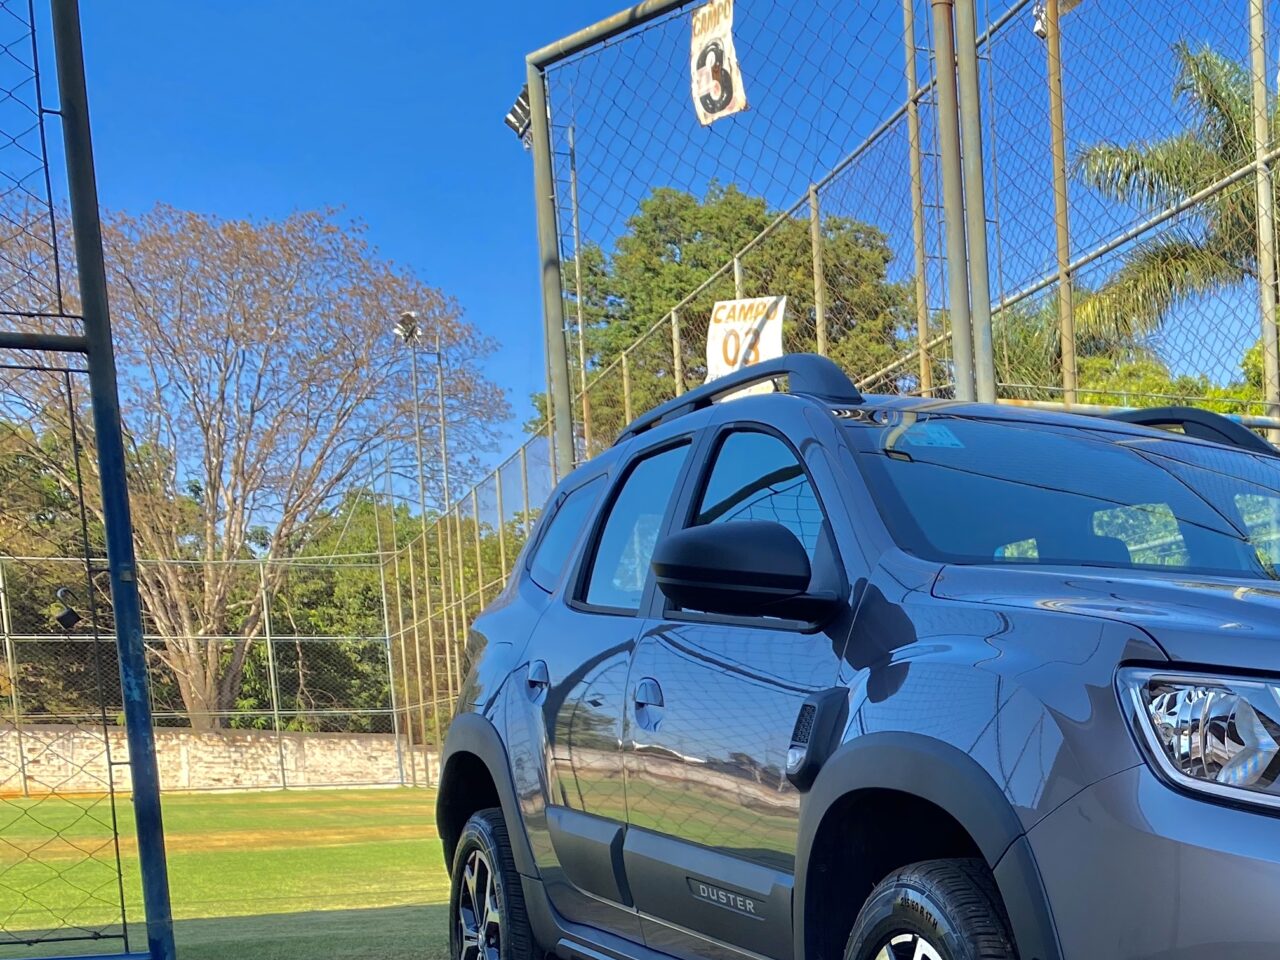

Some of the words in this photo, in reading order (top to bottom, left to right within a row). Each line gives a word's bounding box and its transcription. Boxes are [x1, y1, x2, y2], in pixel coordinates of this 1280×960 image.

[693, 1, 731, 37] CAMPO
[697, 40, 733, 114] 3
[713, 302, 778, 324] CAMPO
[699, 885, 755, 913] DUSTER
